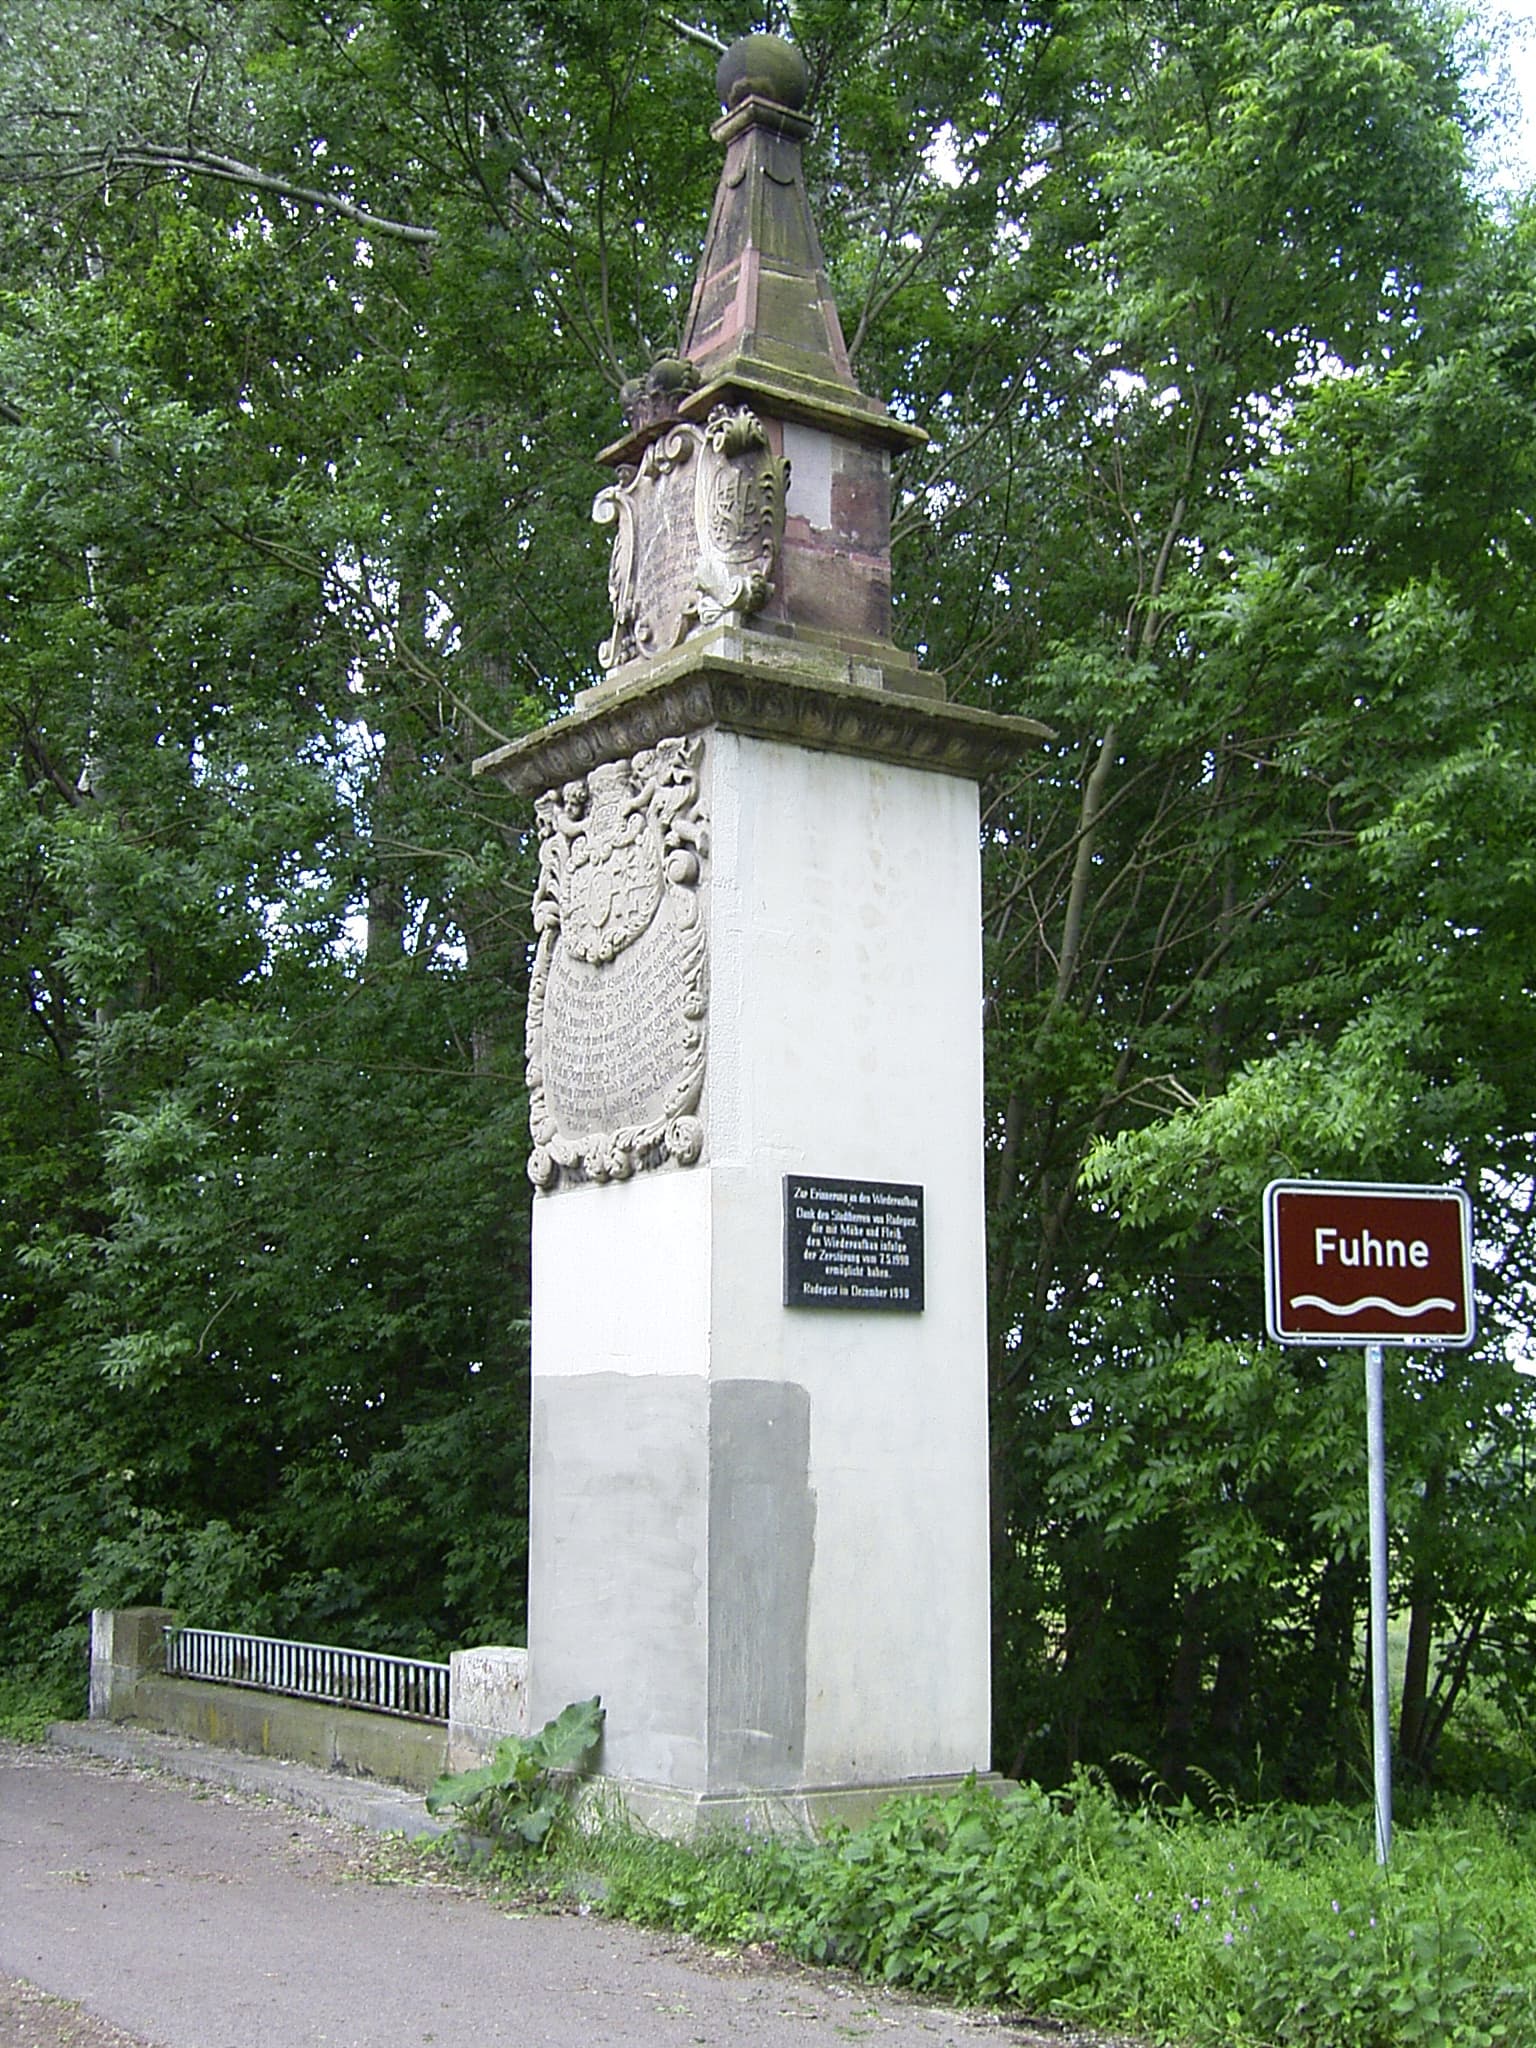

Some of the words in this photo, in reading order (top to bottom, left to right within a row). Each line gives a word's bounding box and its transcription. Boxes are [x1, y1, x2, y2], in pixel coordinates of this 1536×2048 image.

[793, 1186, 808, 1198] Zur
[810, 1187, 848, 1203] Erinnerung
[859, 1192, 870, 1203] den
[872, 1192, 918, 1208] Wiederaufbau
[796, 1206, 815, 1219] Dank
[817, 1208, 830, 1220] den
[872, 1215, 884, 1224] von
[811, 1221, 823, 1234] die
[825, 1223, 838, 1234] mit
[840, 1223, 863, 1236] Mühe
[865, 1226, 879, 1238] und
[806, 1234, 821, 1247] den
[823, 1236, 878, 1250] Wiederaufbau
[880, 1240, 907, 1253] infolge
[1314, 1227, 1429, 1268] Fuhne
[803, 1248, 817, 1260] der
[818, 1248, 860, 1264] Zerstörung
[861, 1254, 877, 1264] vom
[825, 1264, 863, 1278] ermöglicht
[867, 1266, 892, 1278] haben.
[803, 1282, 838, 1296] Radegast
[839, 1284, 849, 1295] im
[851, 1284, 887, 1298] Dezember
